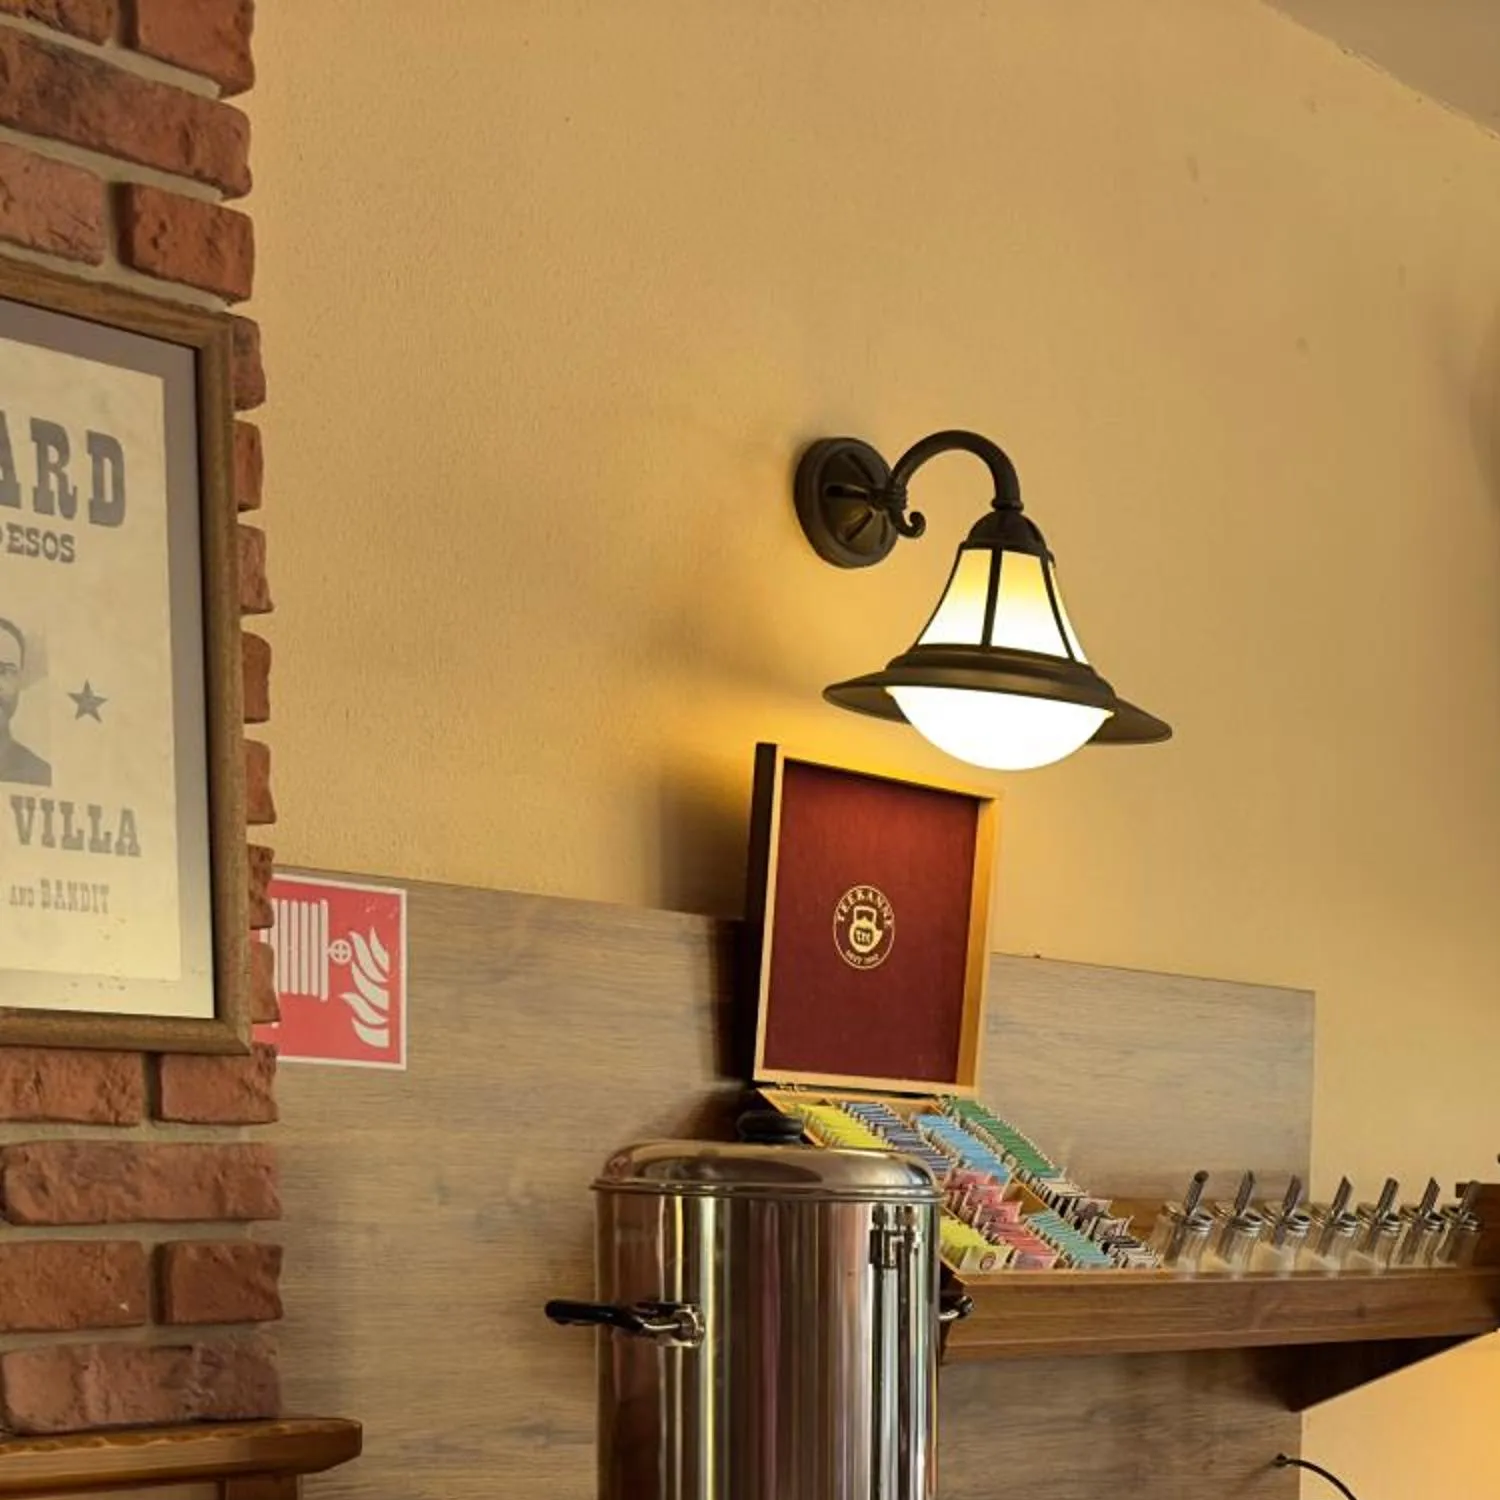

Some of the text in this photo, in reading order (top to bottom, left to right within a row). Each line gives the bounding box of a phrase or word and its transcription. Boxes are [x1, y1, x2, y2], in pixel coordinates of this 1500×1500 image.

[0, 521, 75, 564] ESOS
[9, 794, 142, 858] VILLA
[40, 878, 110, 914] BANDIT
